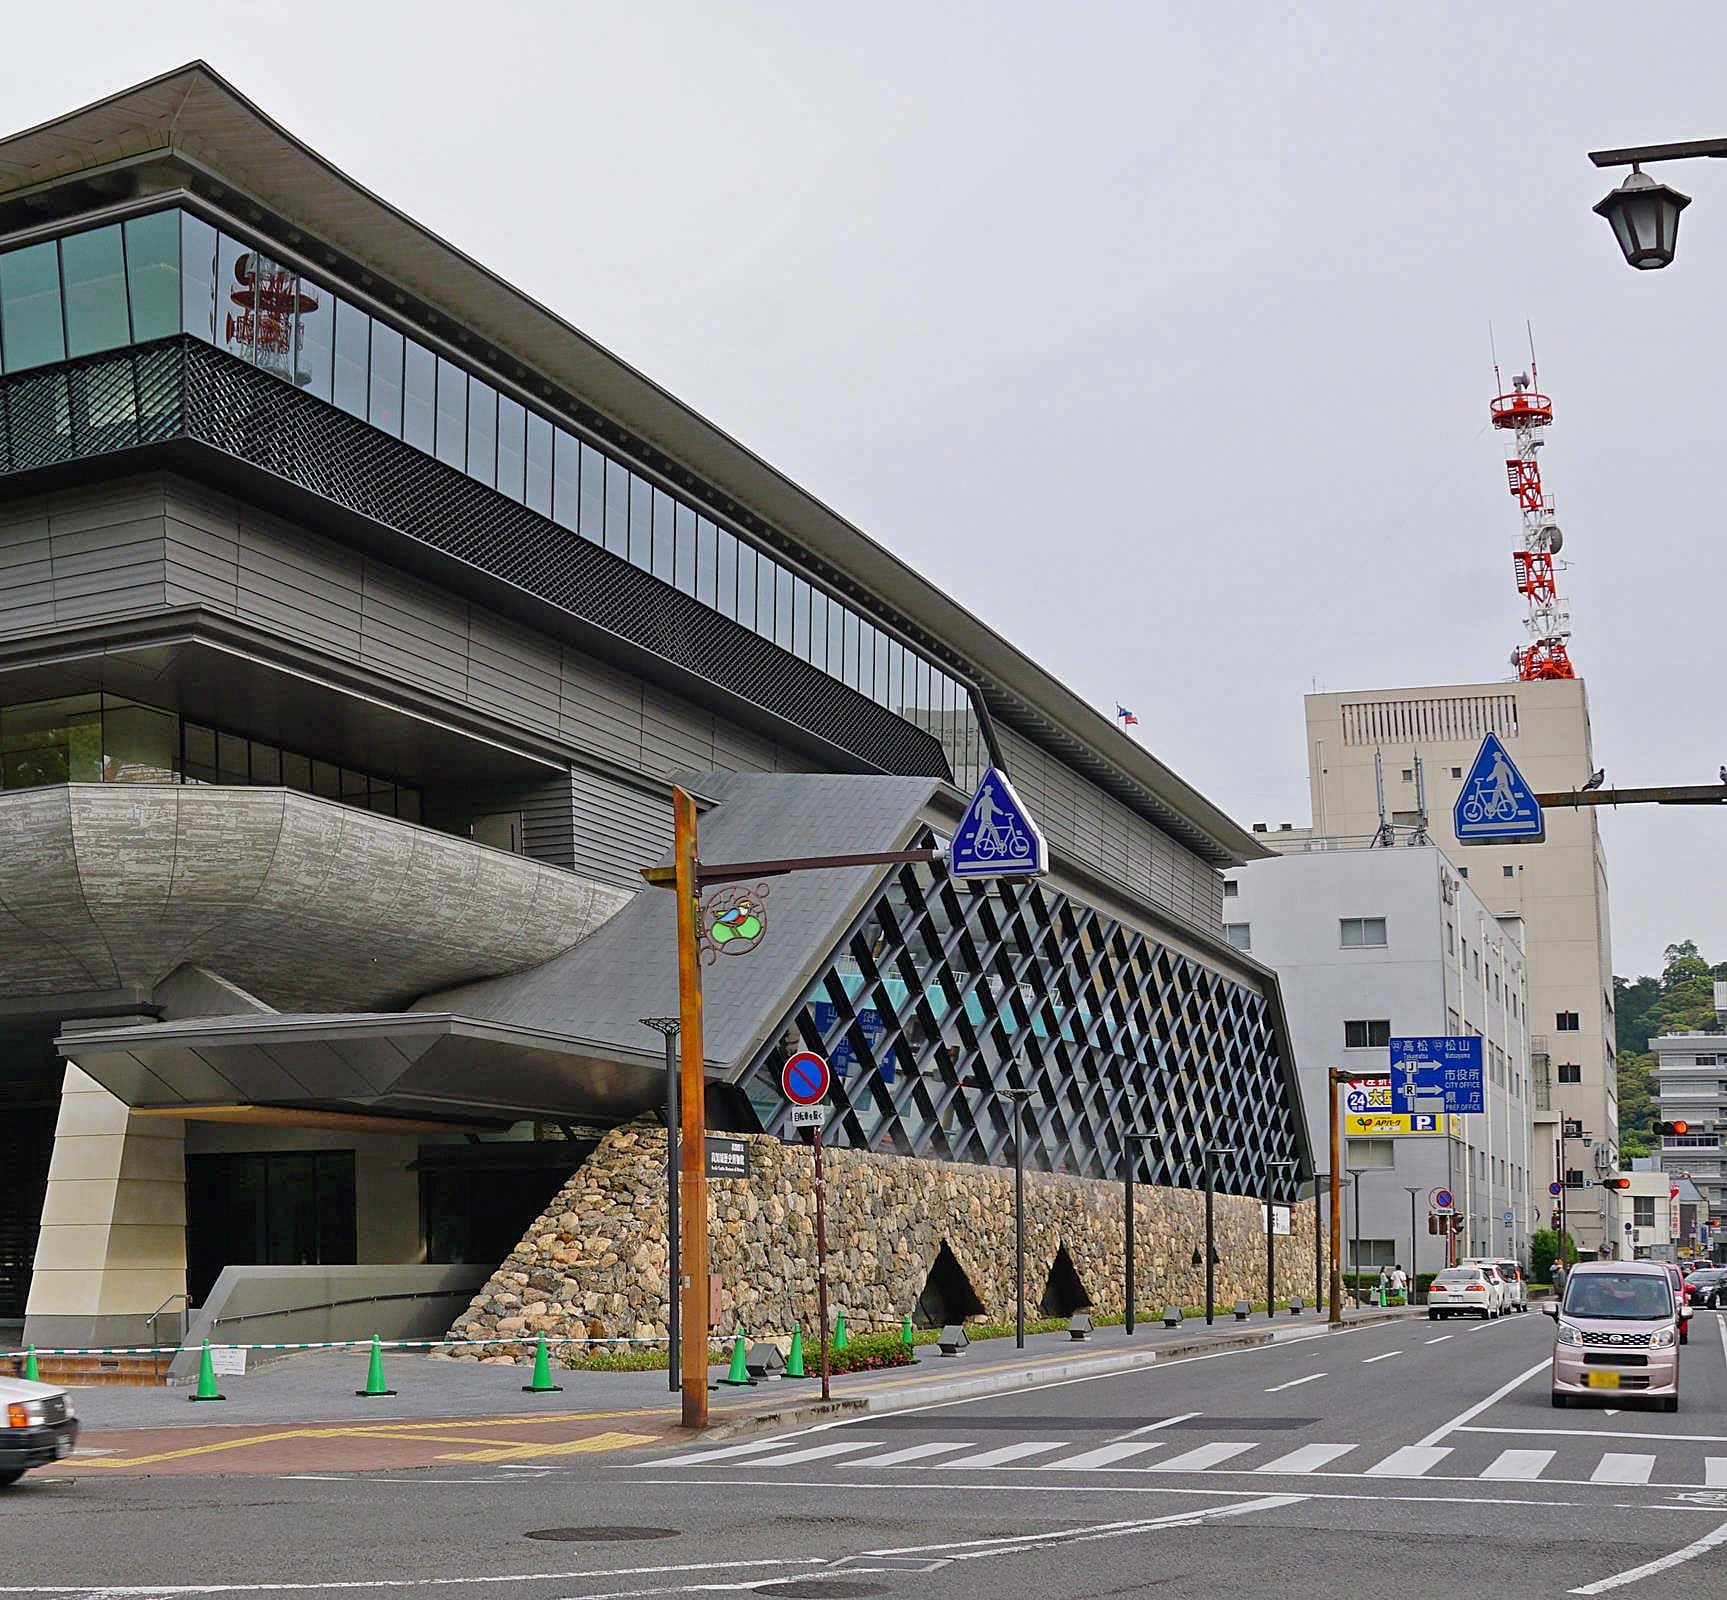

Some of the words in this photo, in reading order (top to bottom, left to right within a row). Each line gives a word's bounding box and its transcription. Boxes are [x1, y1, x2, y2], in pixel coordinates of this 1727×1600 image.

[1403, 1040, 1428, 1052] 高松
[1445, 1040, 1470, 1051] 松山
[1444, 1069, 1480, 1080] 市役所
[1350, 1094, 1365, 1105] 24
[1445, 1091, 1480, 1103] 県庁
[1416, 1115, 1431, 1129] P
